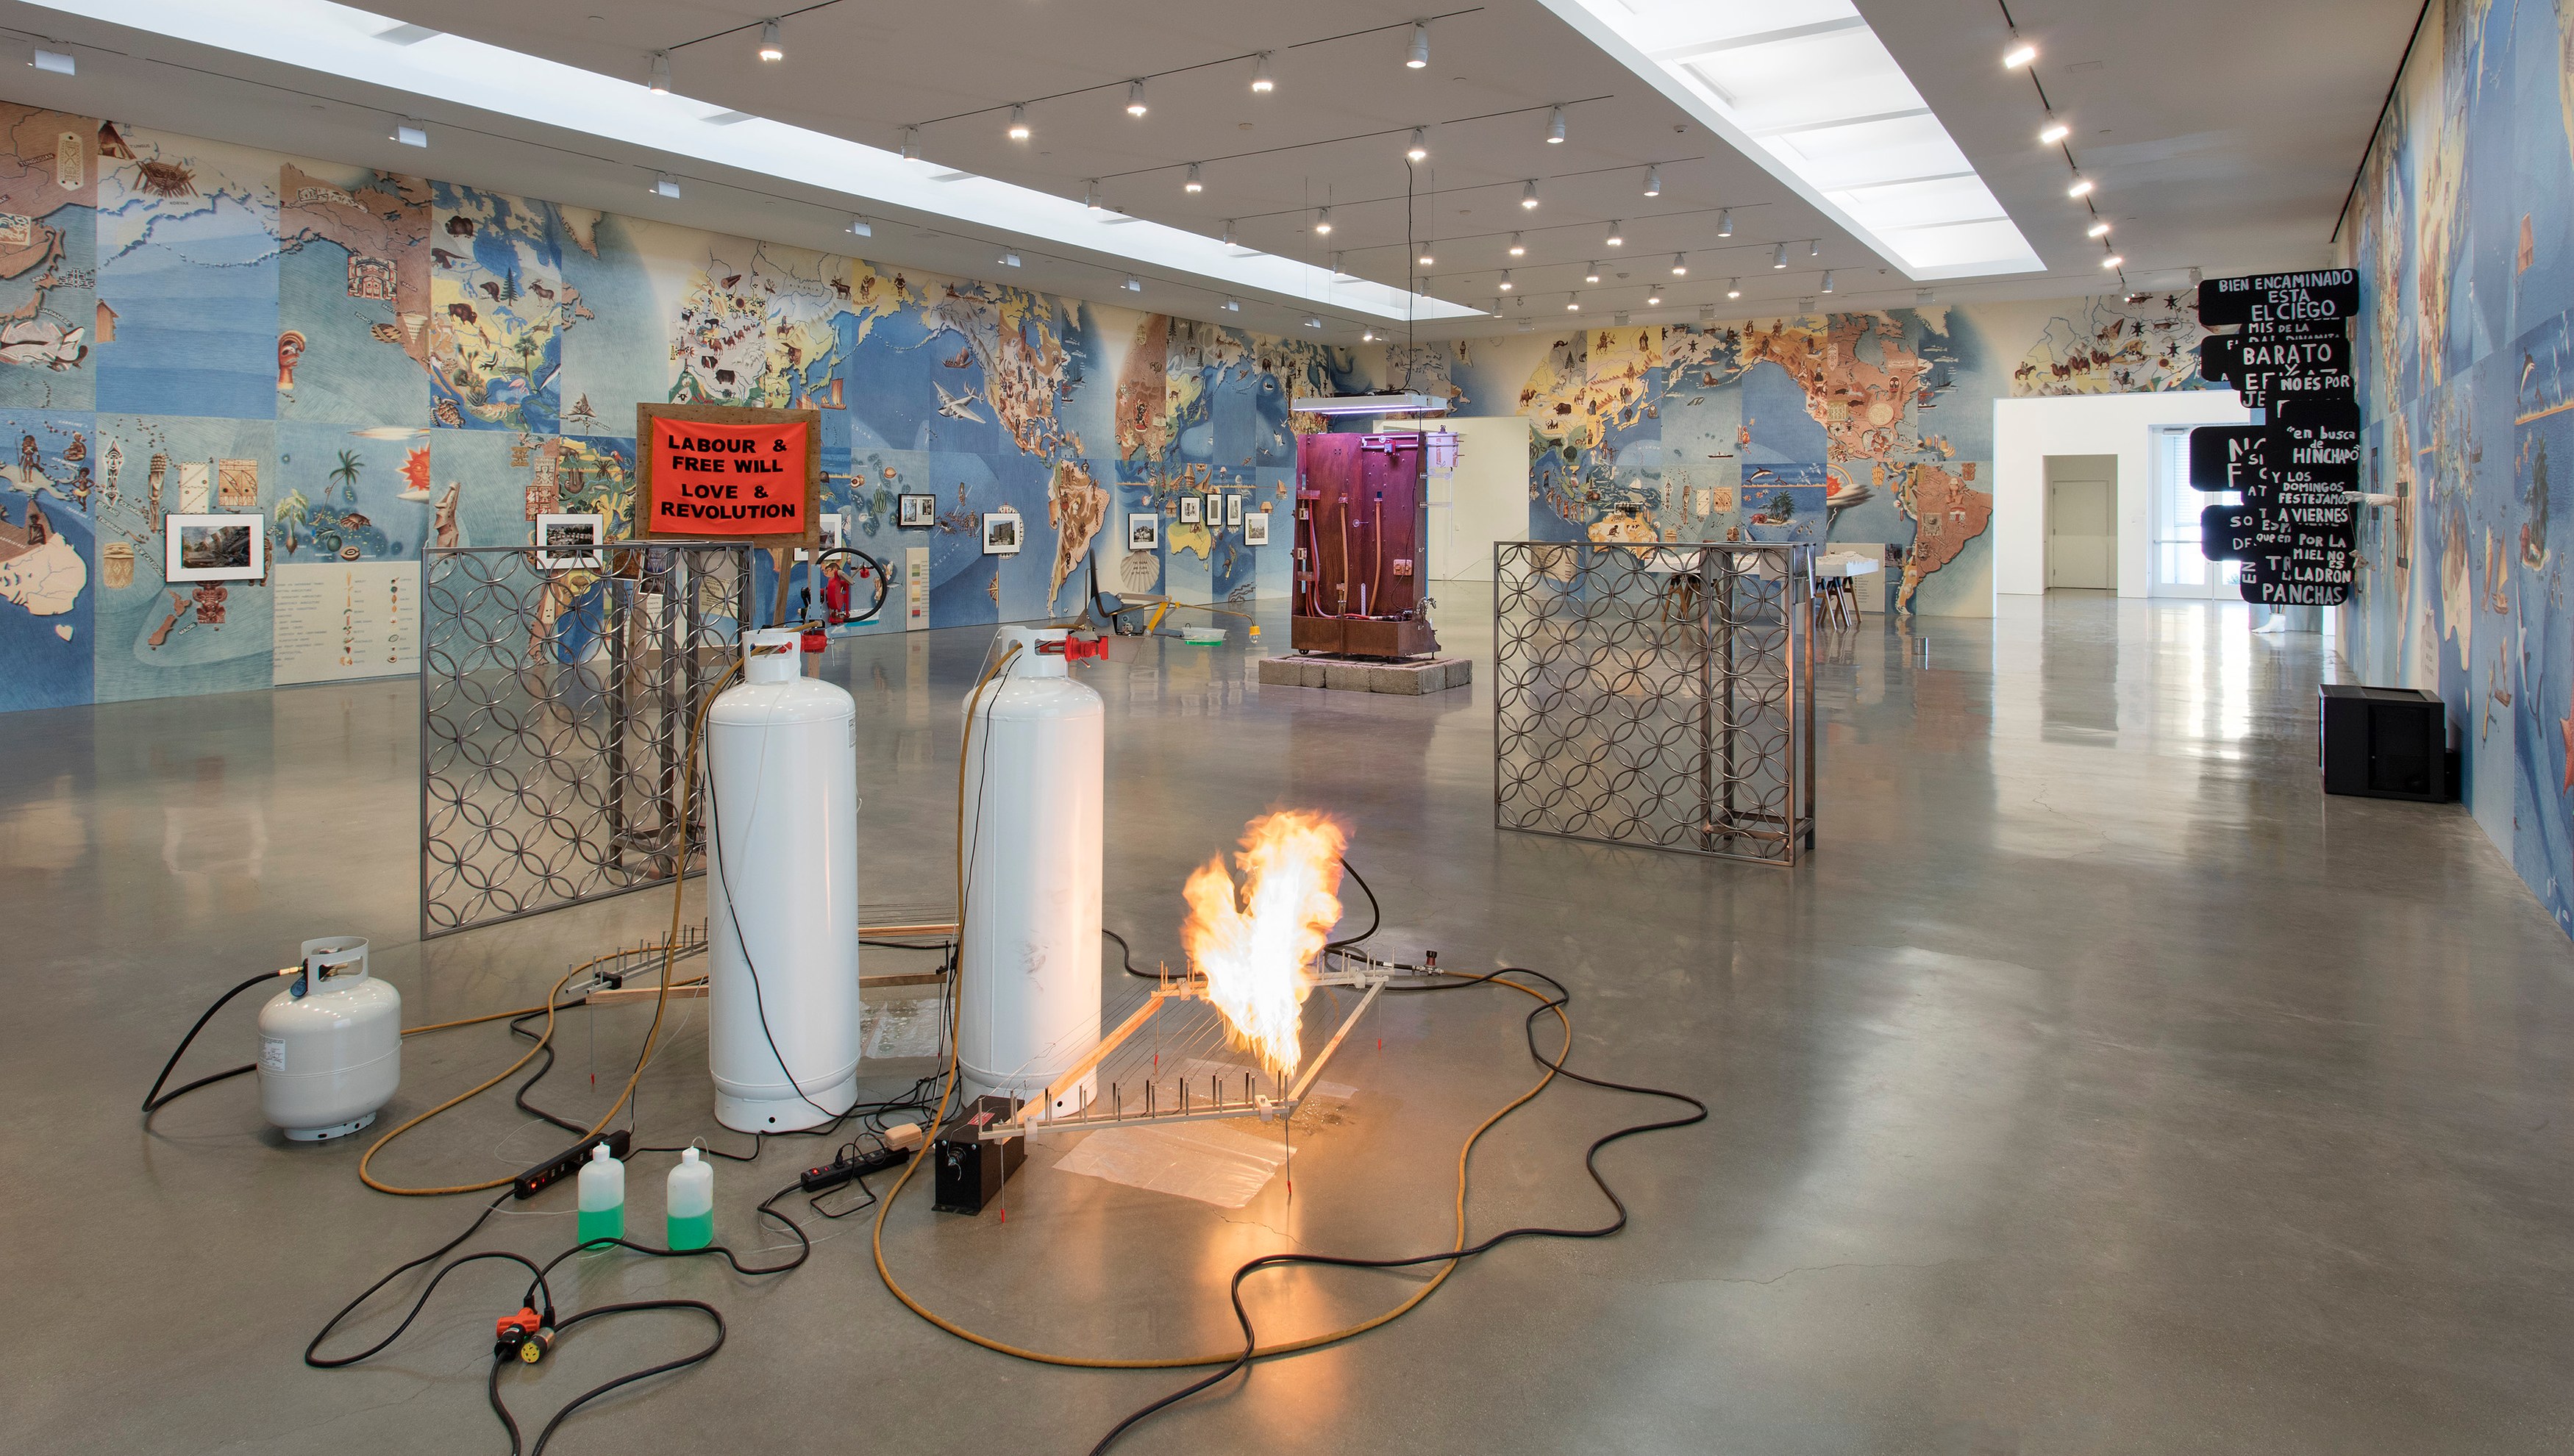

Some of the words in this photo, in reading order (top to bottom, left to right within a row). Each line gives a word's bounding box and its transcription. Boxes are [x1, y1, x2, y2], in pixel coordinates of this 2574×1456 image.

[2219, 279, 2249, 293] BIEN
[2254, 270, 2353, 290] ENCAMINADO
[2268, 289, 2310, 303] ESTA
[2251, 304, 2274, 321] EL
[2276, 299, 2336, 320] CIEGO
[2248, 323, 2273, 333] MIS
[2278, 324, 2292, 332] DE
[2295, 324, 2309, 332] LA
[2243, 343, 2331, 365] BARATO
[2281, 377, 2300, 390] NO
[2305, 377, 2320, 390] ES
[2325, 375, 2350, 388] POR
[2320, 426, 2356, 440] busca
[668, 435, 756, 453] LABOUR
[772, 439, 787, 452] &
[2310, 439, 2323, 449] de
[672, 456, 724, 473] FREE
[734, 460, 783, 473] WILL
[2288, 471, 2311, 482] LOS
[682, 483, 738, 499] LOVE
[754, 485, 769, 499] &
[2283, 482, 2345, 493] DOMINGOS
[660, 501, 795, 519] REVOLUTION
[2278, 507, 2289, 522] A
[2292, 507, 2348, 523] VIERNES
[2299, 533, 2323, 547] POR
[2328, 534, 2347, 549] LA
[2293, 548, 2324, 560] MIEL
[2327, 552, 2344, 561] NO
[2328, 560, 2344, 569] ES
[2295, 567, 2351, 583] LADRON
[2262, 583, 2343, 604] PANCHAS
